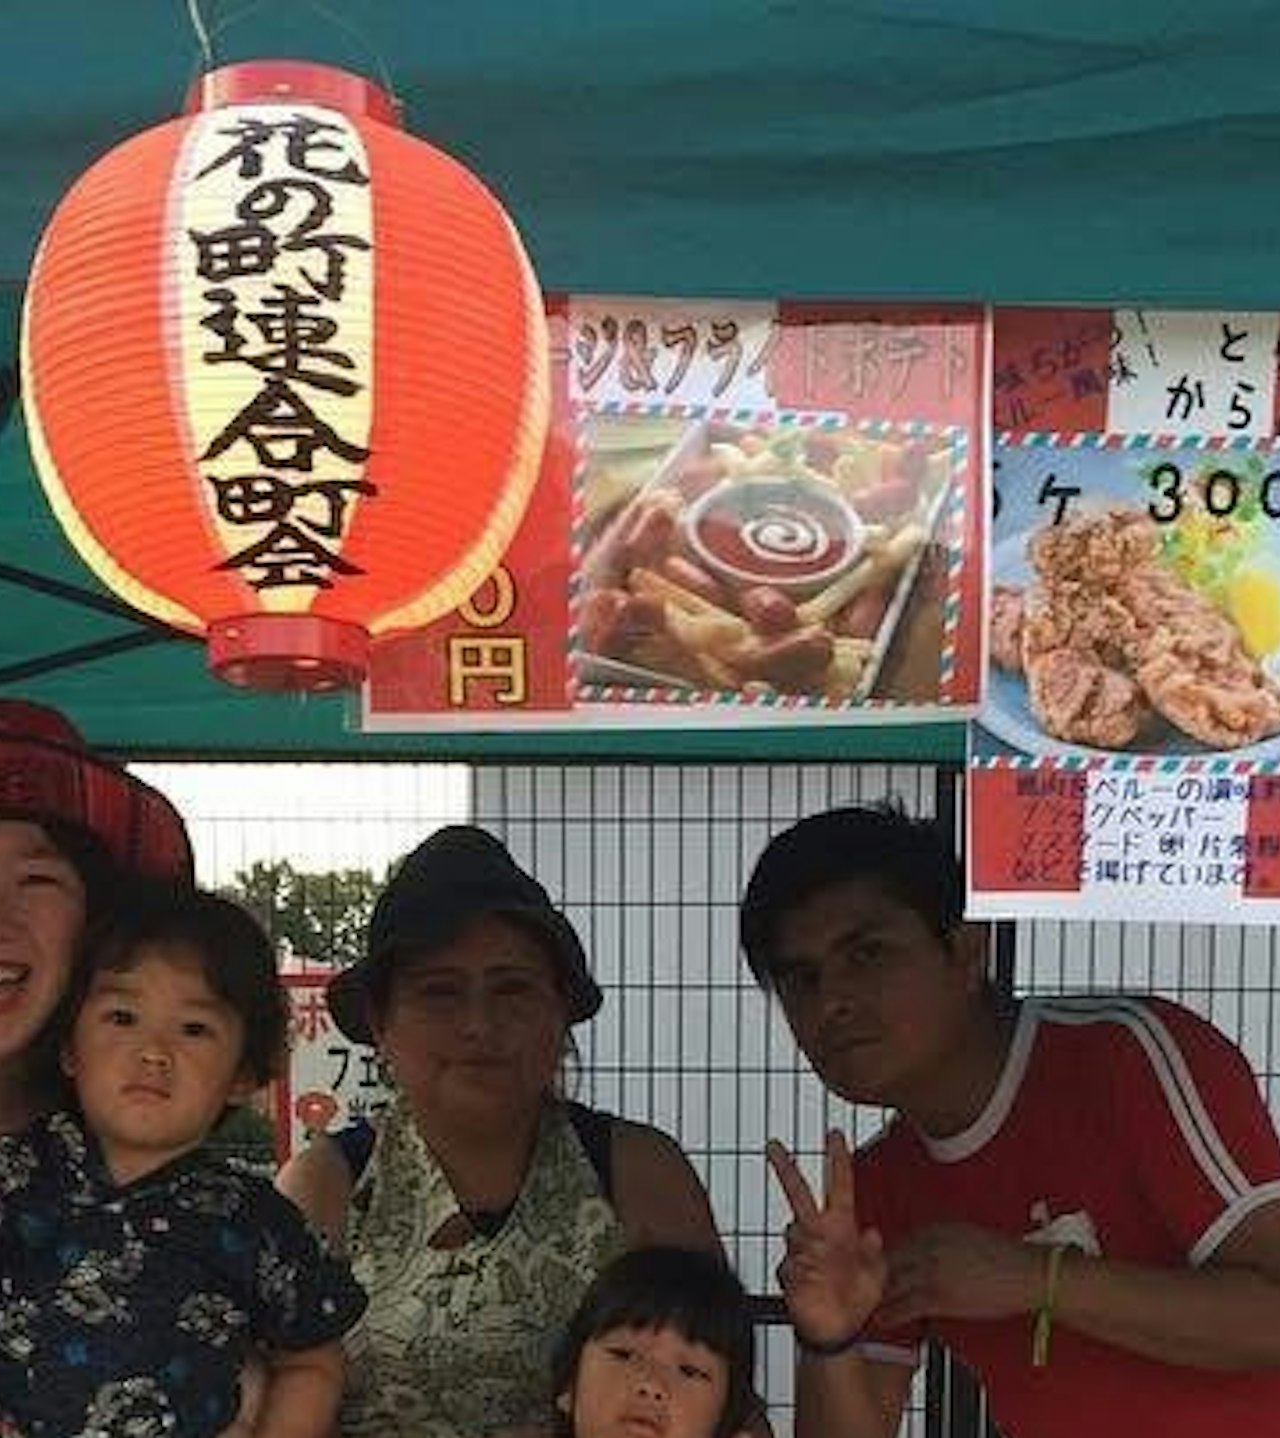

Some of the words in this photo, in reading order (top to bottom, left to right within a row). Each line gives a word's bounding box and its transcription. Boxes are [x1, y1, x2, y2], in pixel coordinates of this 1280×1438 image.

[190, 113, 379, 590] 花の町連合町会
[548, 316, 968, 400] ジ&フライドポテト
